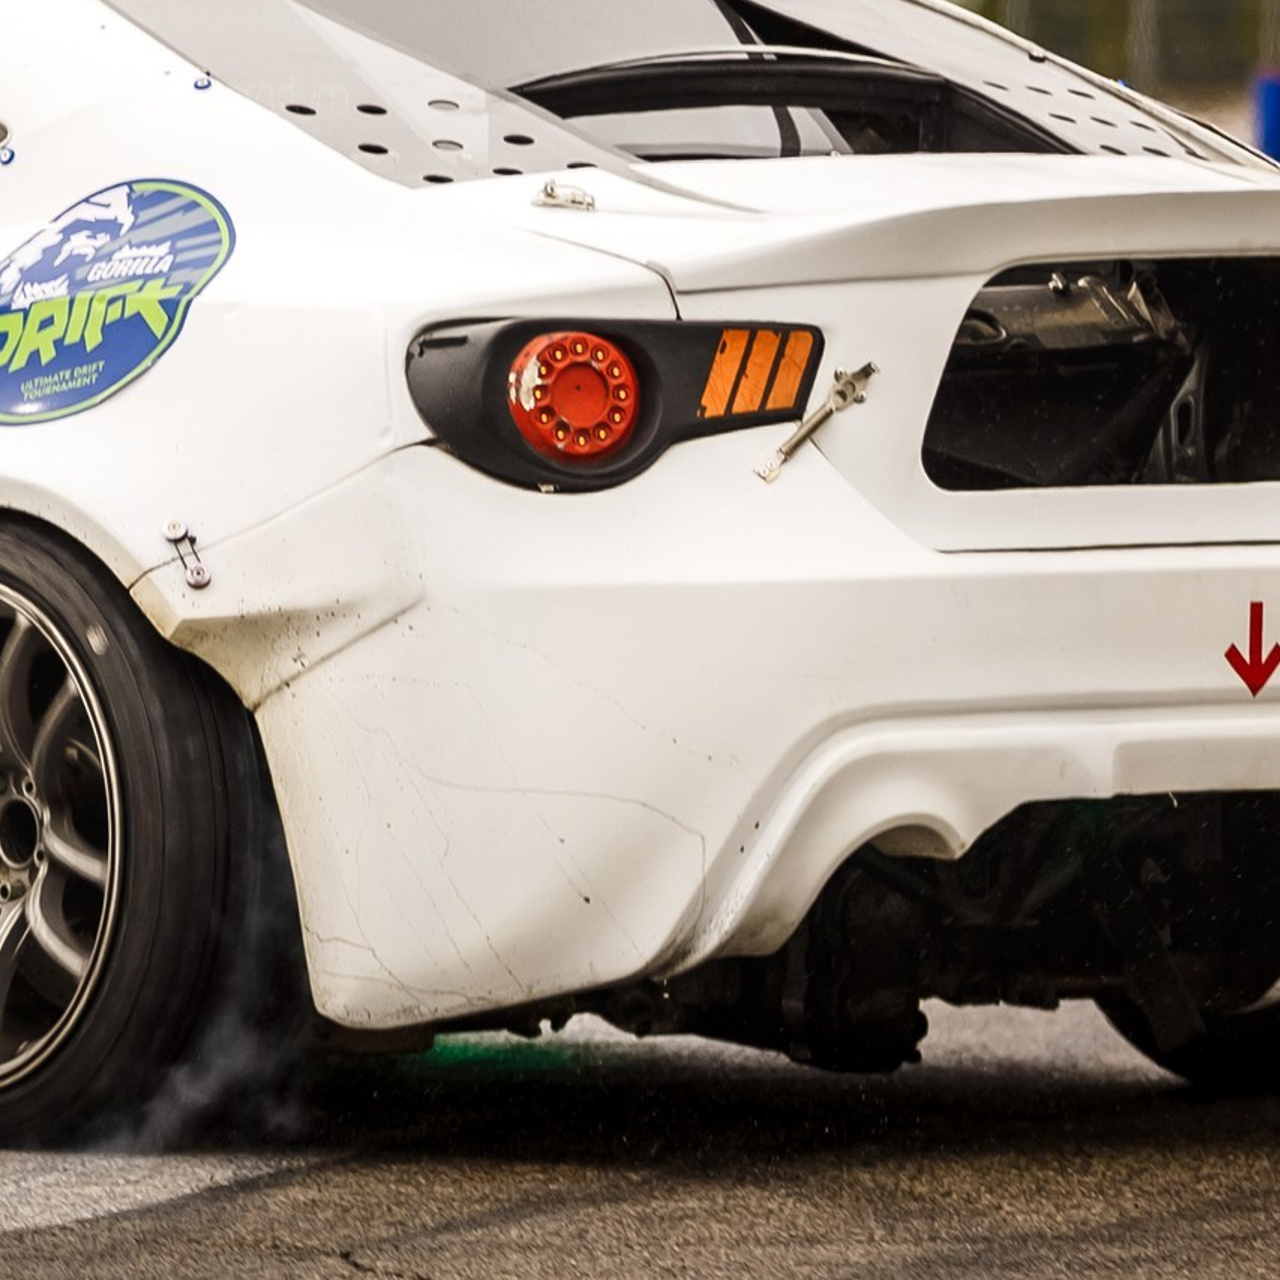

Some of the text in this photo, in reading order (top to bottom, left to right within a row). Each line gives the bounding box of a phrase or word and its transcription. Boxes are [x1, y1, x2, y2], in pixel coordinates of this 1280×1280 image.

[88, 255, 174, 281] GORILLA
[21, 361, 104, 393] ULTIMATE DRIFT
[23, 374, 97, 400] TOURNAMENT
